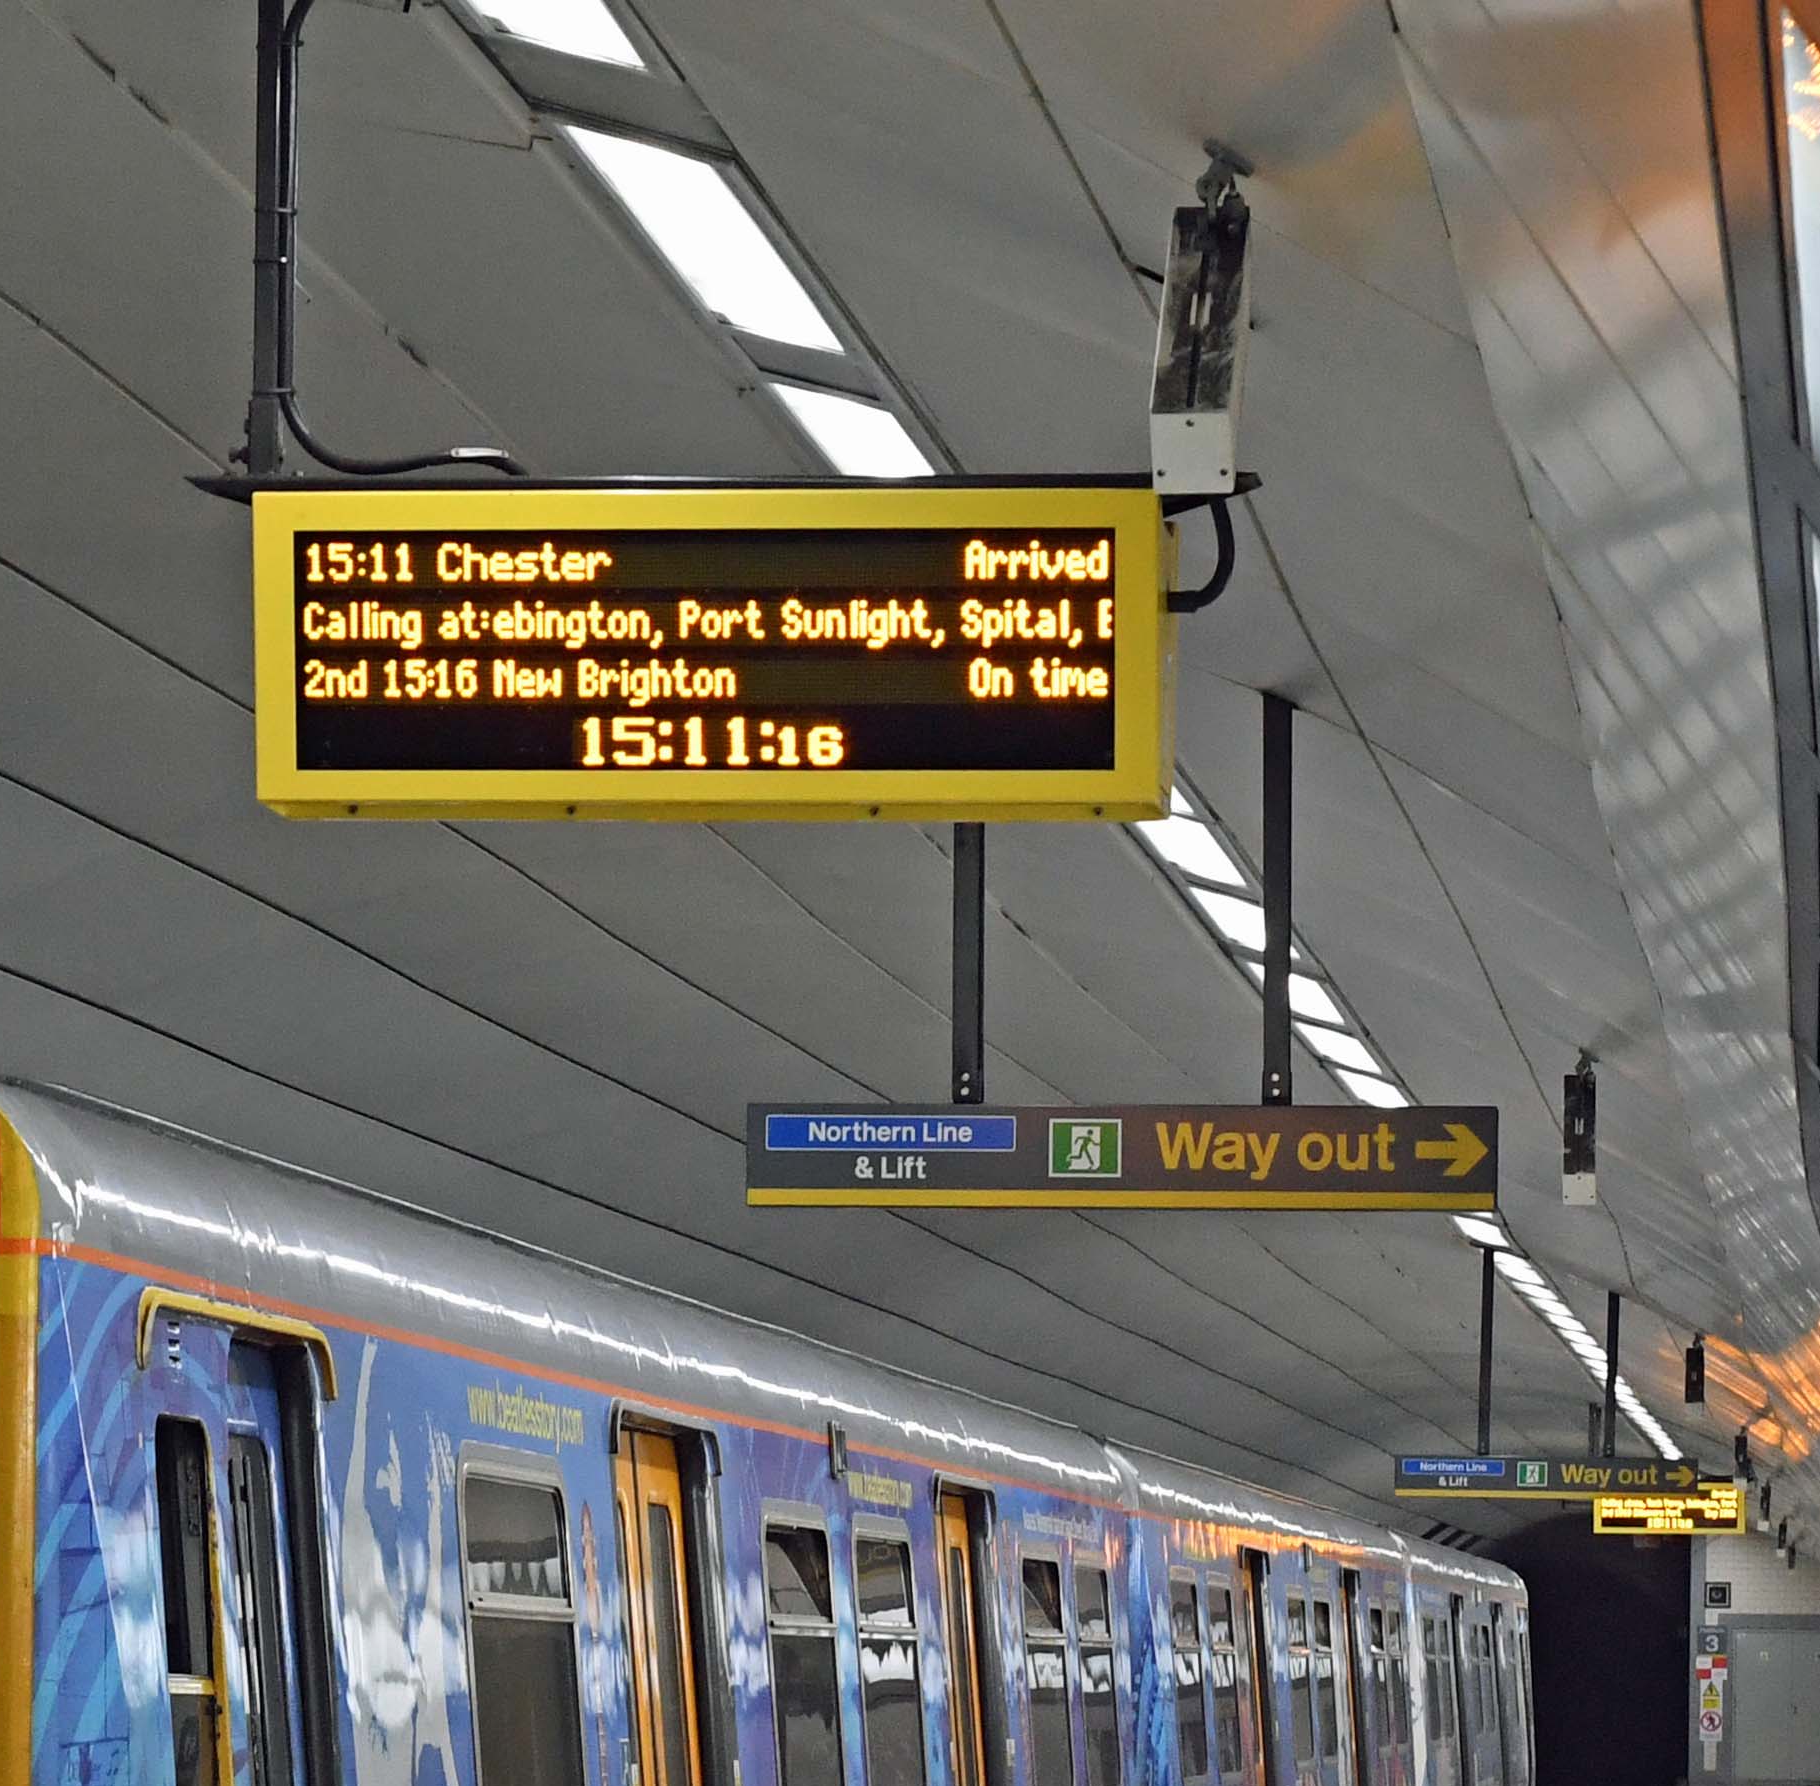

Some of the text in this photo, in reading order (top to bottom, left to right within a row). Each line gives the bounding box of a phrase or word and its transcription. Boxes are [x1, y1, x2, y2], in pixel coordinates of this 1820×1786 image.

[306, 539, 1110, 583] 15:11 Chester Arrived
[303, 600, 424, 650] Calling
[678, 599, 766, 640] Port
[780, 598, 946, 650] Sunlight,
[959, 598, 1083, 649] Spital,
[304, 656, 1109, 708] 2nd 15:16 New Brighton On time
[581, 715, 846, 768] 15:11:16
[808, 1120, 1396, 1180] Northern Line Way out
[854, 1155, 928, 1179] & Lift
[1419, 1460, 1658, 1488] Northern Line Way out
[1450, 1477, 1468, 1488] Lift
[1705, 1634, 1720, 1652] 3
